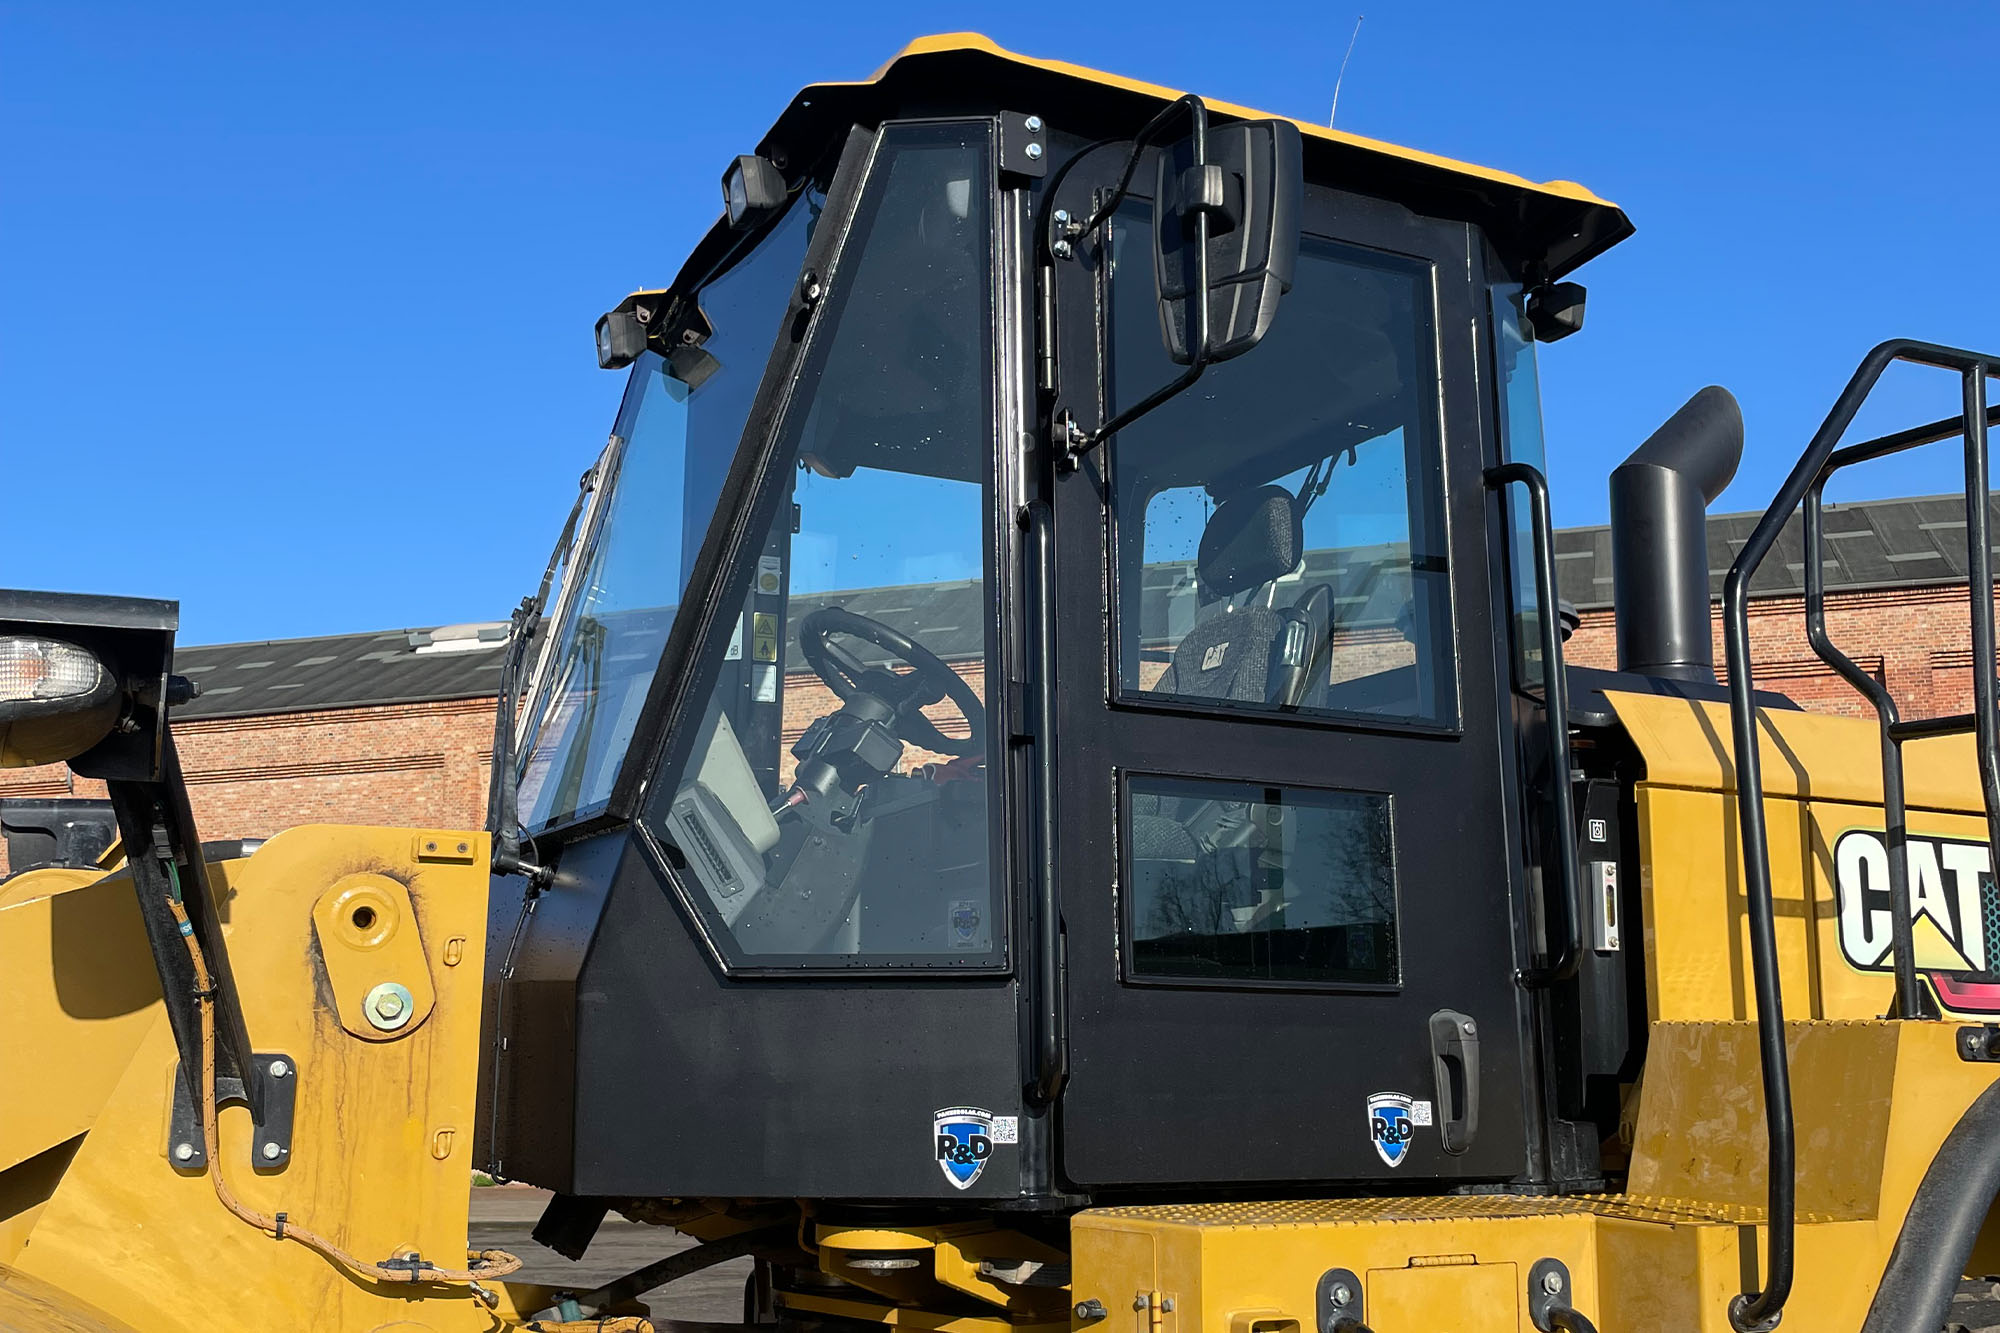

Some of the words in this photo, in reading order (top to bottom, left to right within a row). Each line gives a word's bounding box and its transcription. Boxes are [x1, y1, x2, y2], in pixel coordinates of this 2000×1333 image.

[1202, 641, 1230, 670] CAT
[1836, 832, 1990, 972] CAT
[1372, 1117, 1414, 1144] R&D
[937, 1134, 993, 1165] R&D
